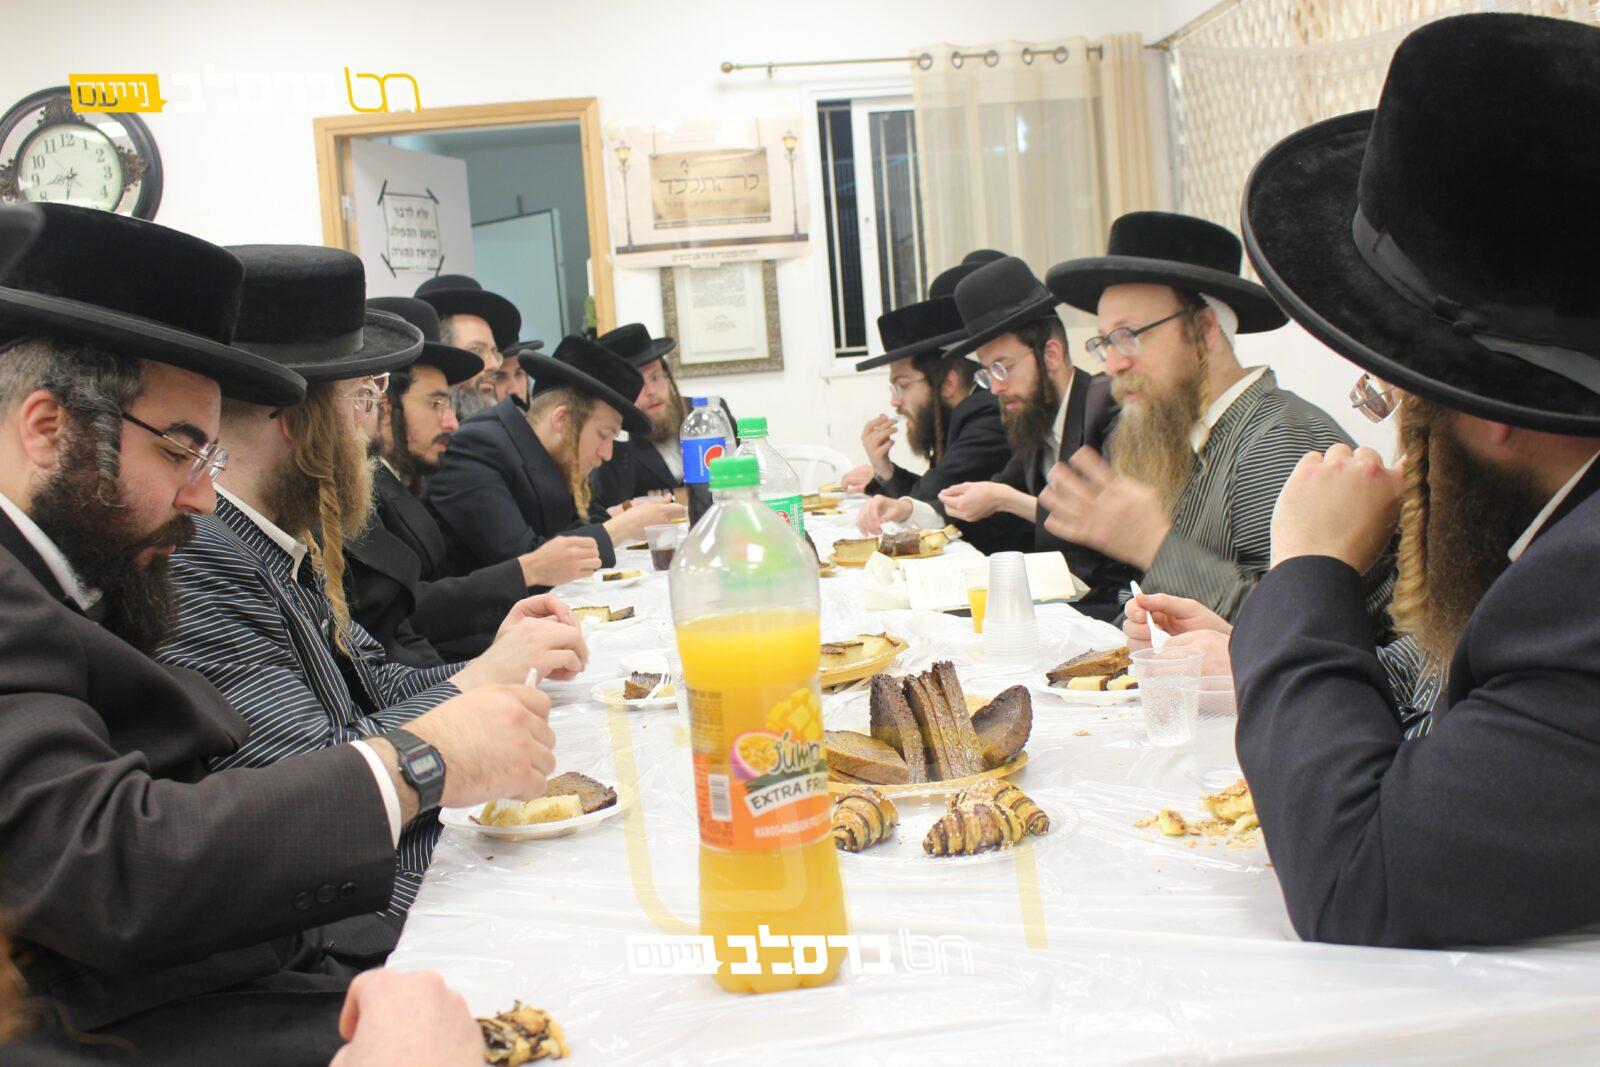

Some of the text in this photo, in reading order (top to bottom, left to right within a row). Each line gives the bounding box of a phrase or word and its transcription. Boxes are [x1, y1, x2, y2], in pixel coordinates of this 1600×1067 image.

[44, 139, 56, 154] 11
[59, 132, 75, 148] 12
[82, 139, 88, 150] 1
[32, 154, 46, 169] 10
[95, 149, 106, 163] 2
[31, 173, 40, 187] 9
[103, 165, 113, 180] 3
[100, 184, 108, 199] 4
[750, 781, 803, 810] EXTRA
